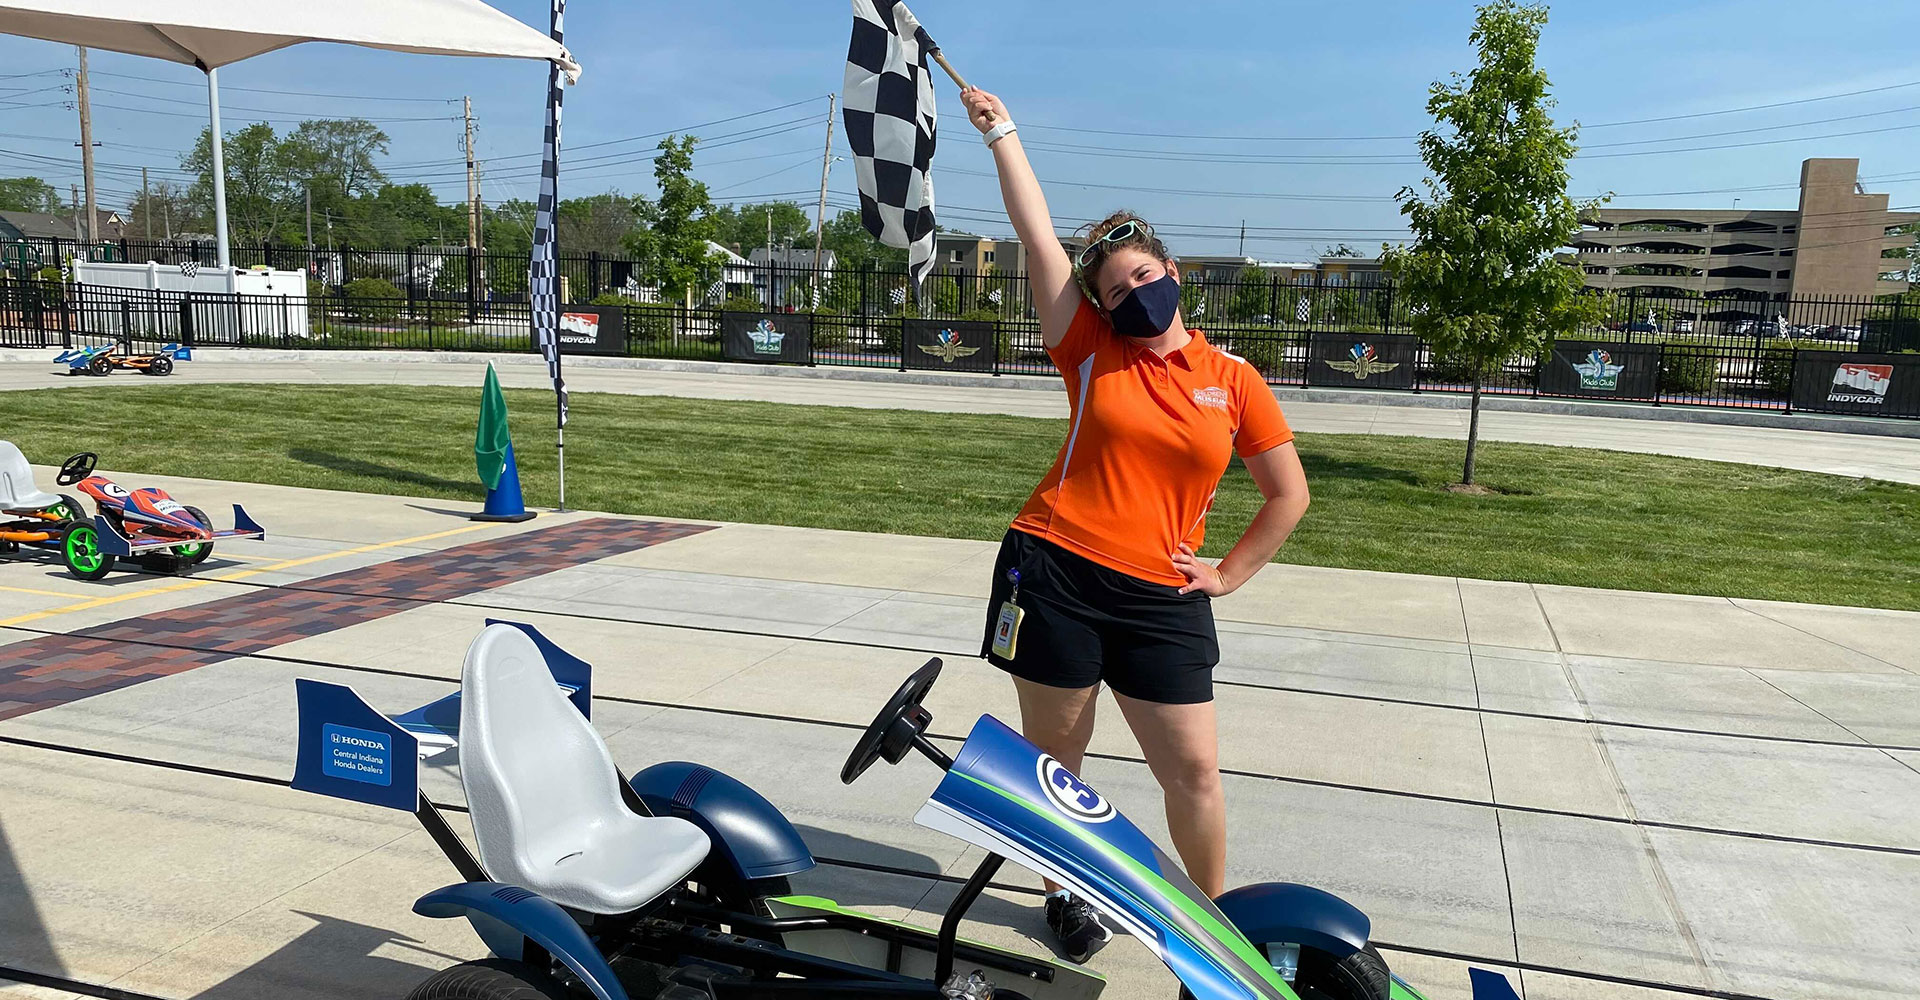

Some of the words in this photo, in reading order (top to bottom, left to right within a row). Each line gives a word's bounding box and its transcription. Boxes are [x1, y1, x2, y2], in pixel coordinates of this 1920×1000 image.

[559, 335, 597, 344] NDYCAR
[1583, 378, 1598, 386] Kids
[1599, 379, 1615, 387] Club
[1827, 394, 1884, 404] INDYCAR
[113, 485, 127, 494] 4
[341, 735, 385, 751] HONDA
[333, 748, 358, 760] Central
[359, 753, 384, 765] Indiana
[333, 758, 356, 770] Honda
[357, 763, 383, 775] Dealers
[1052, 767, 1100, 810] 3
